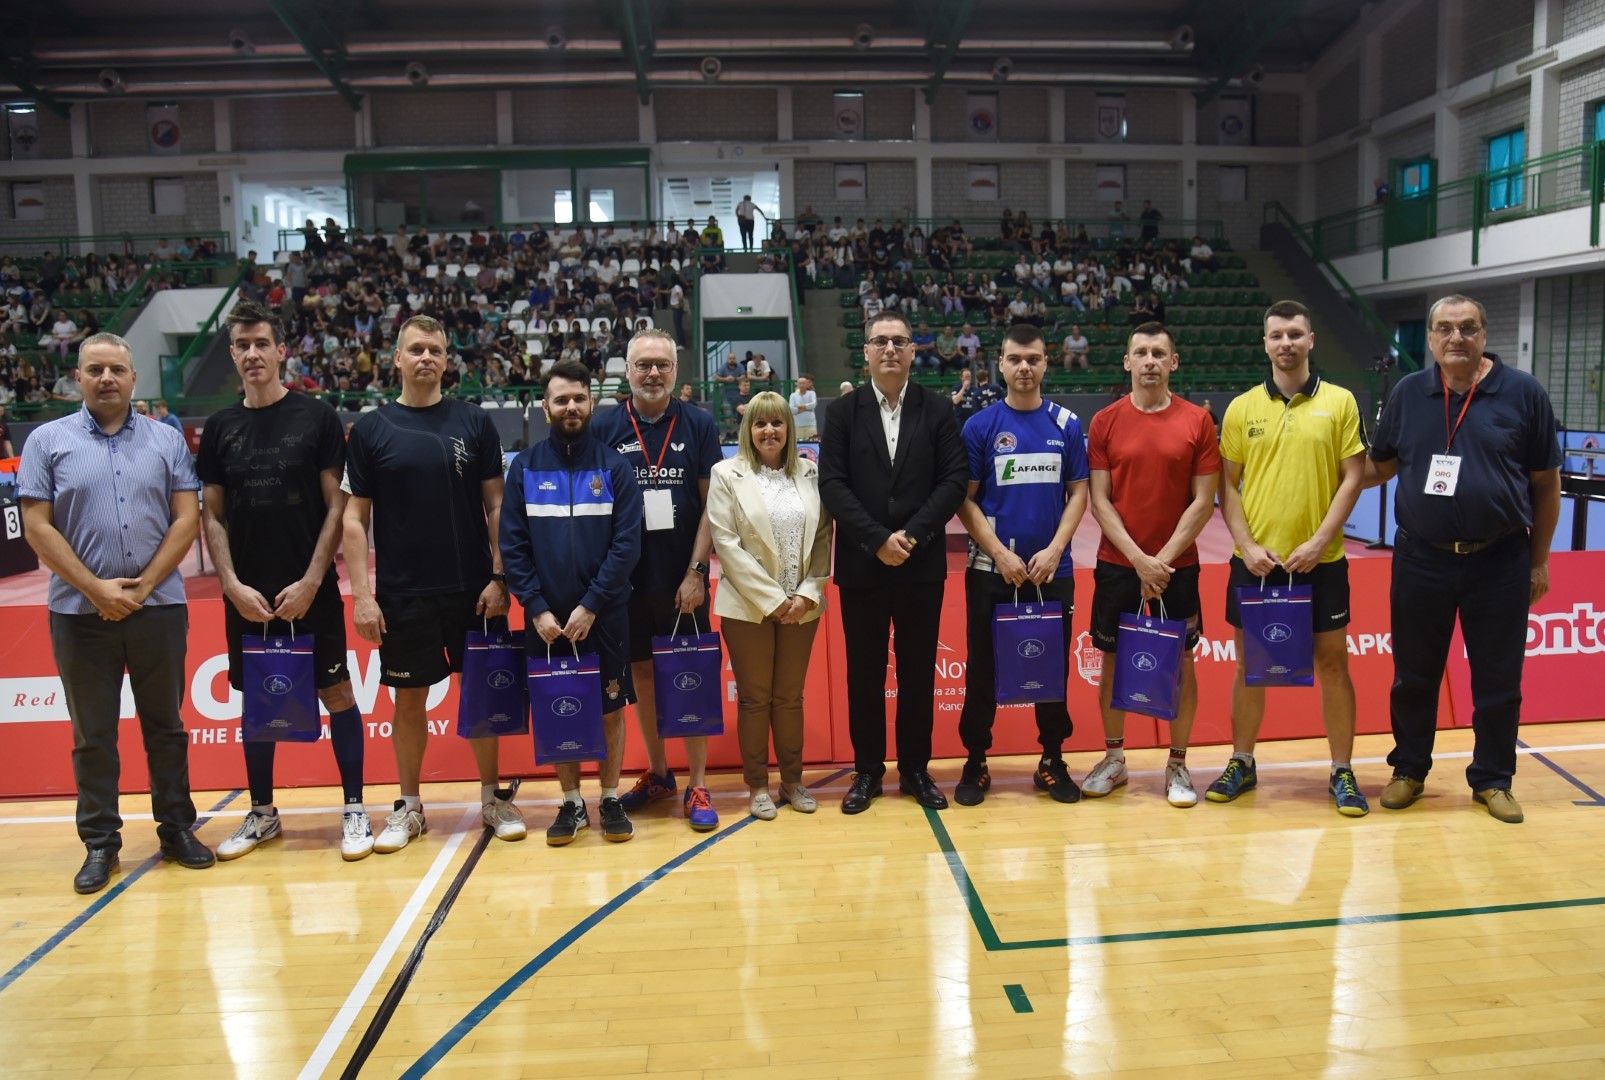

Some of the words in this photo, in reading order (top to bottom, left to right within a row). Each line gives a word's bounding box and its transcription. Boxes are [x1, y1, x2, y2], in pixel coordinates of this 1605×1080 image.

[449, 436, 469, 478] Tibhar
[1011, 465, 1057, 473] LAFARGE
[1434, 470, 1452, 478] ORG
[8, 511, 18, 534] 3
[13, 692, 56, 707] Red
[190, 727, 228, 745] THE
